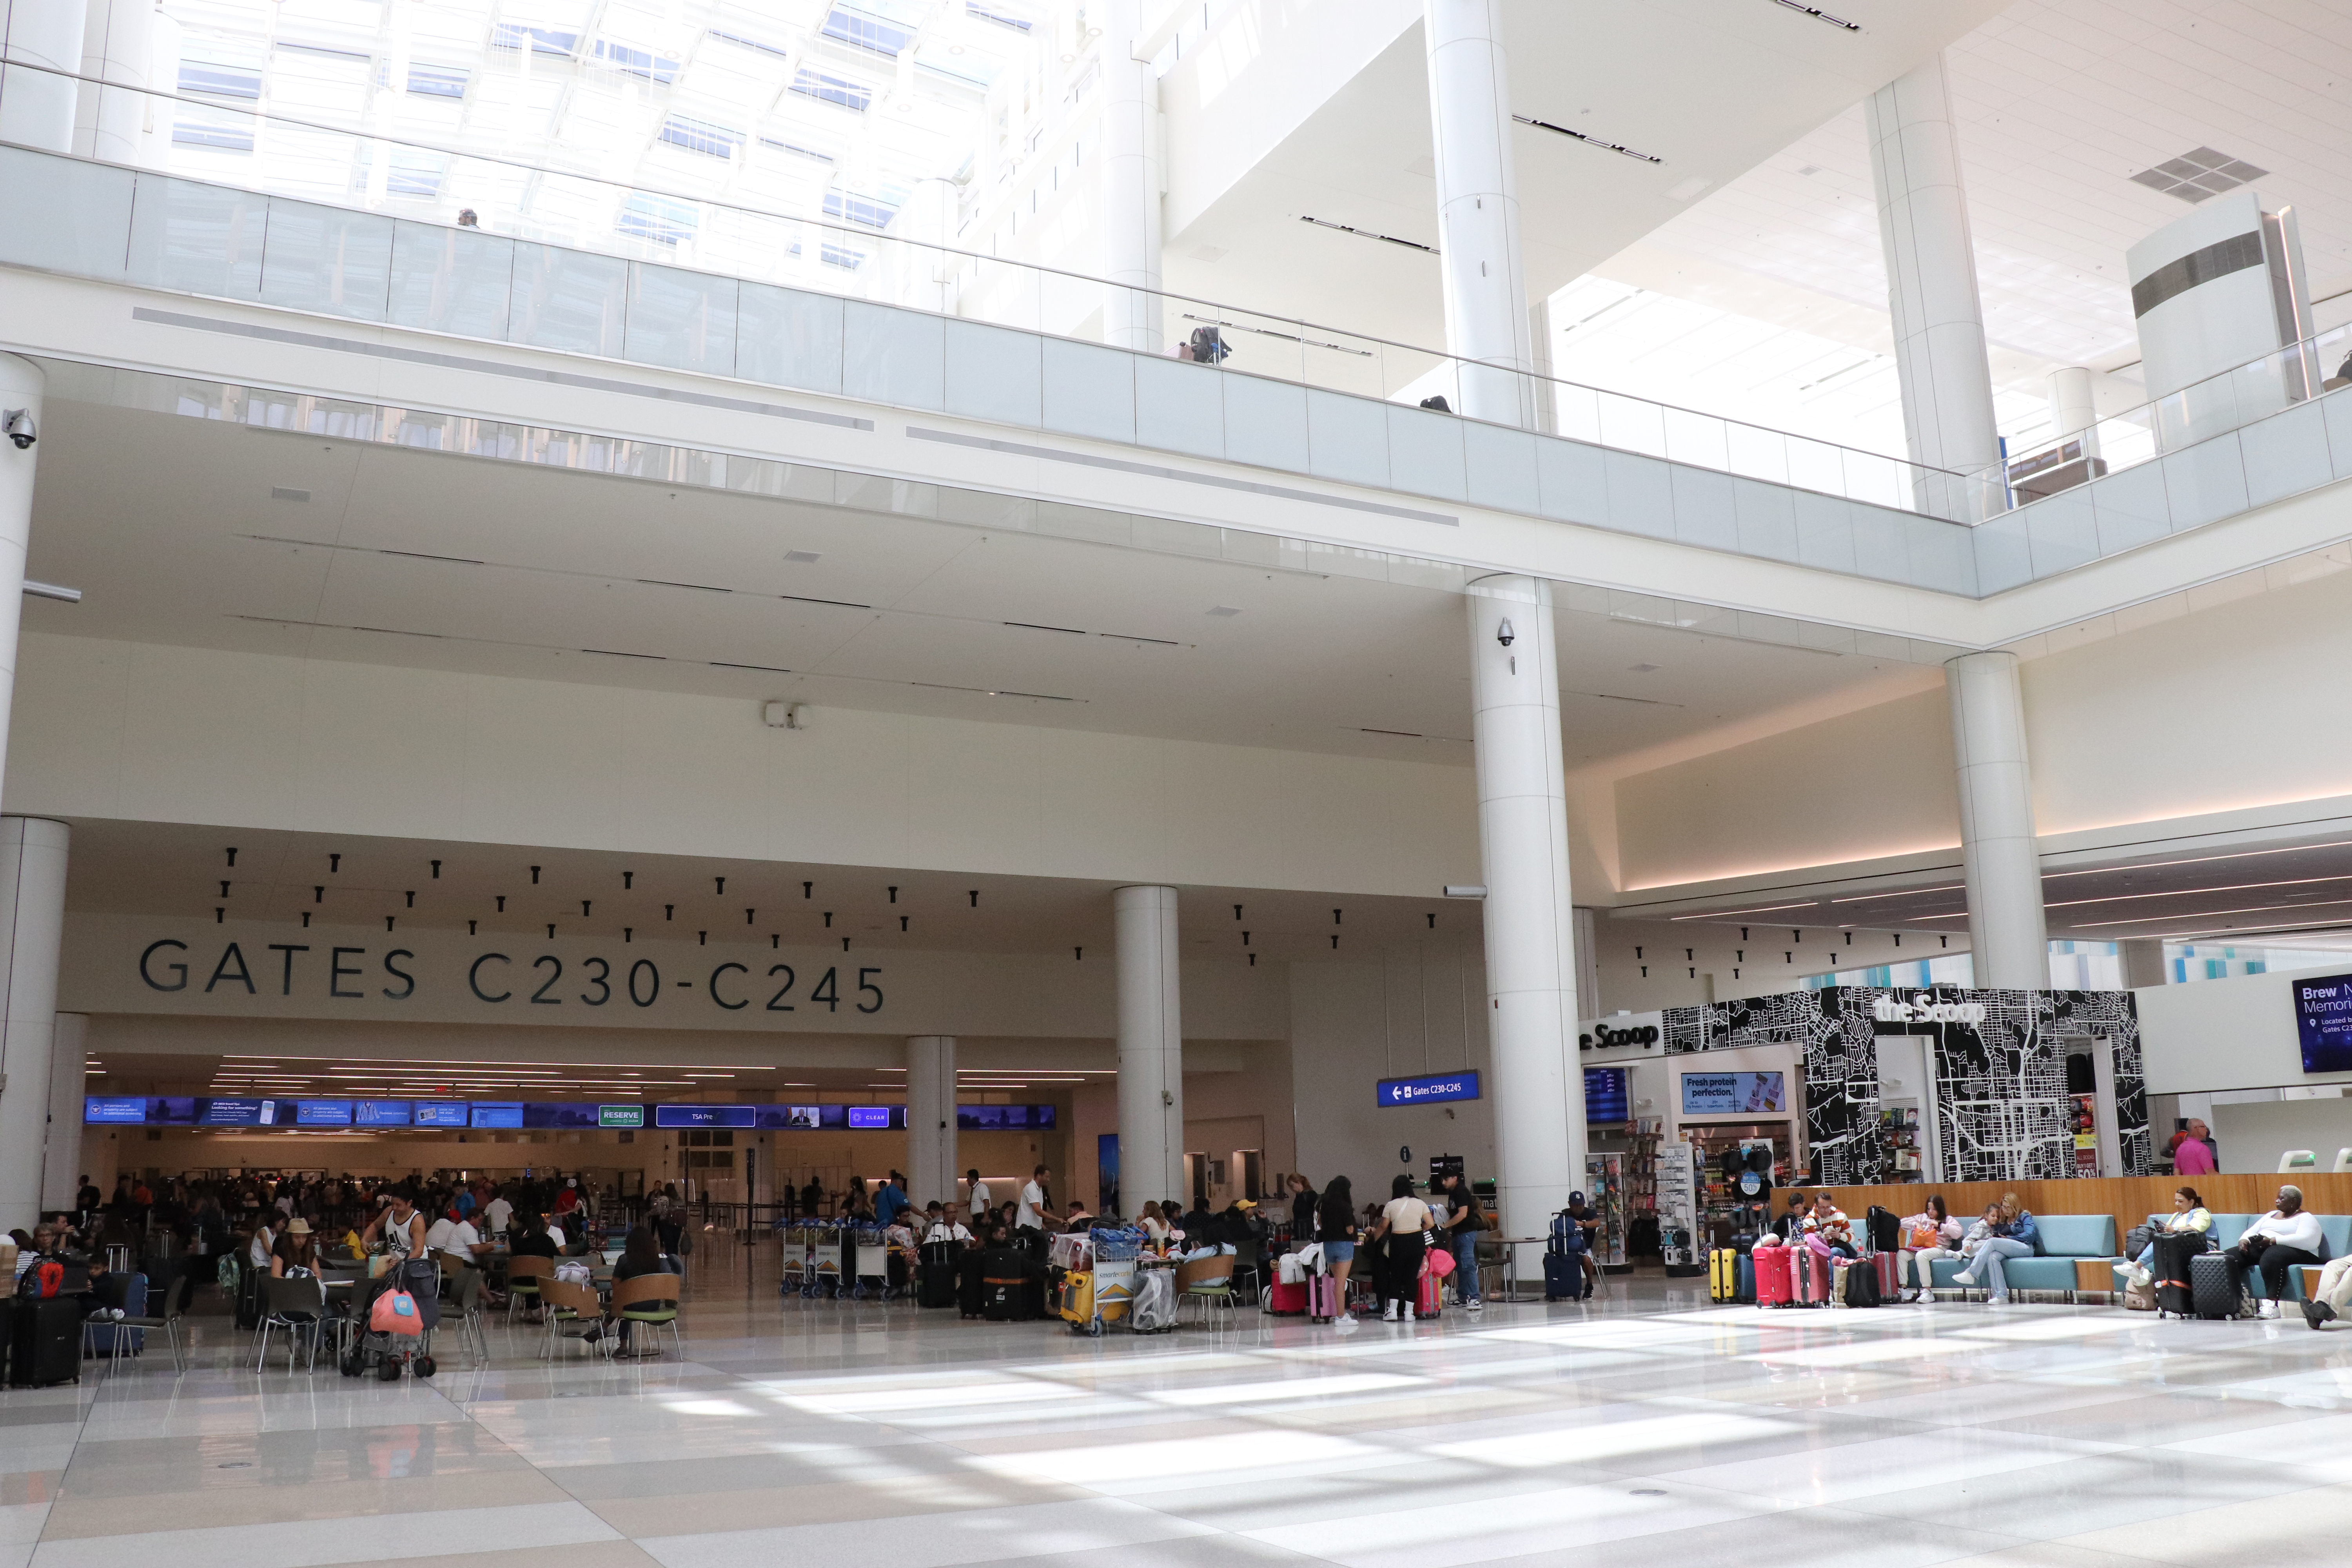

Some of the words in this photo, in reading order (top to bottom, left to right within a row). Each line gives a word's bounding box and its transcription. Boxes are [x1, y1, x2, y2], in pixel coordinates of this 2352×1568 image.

[140, 939, 416, 1000] GATES
[469, 953, 884, 1013] C230-C245
[2303, 988, 2337, 999] Brew
[1872, 994, 1913, 1022] the
[1916, 995, 1985, 1028] Scoop
[2304, 998, 2352, 1013] Memori
[1595, 1024, 1659, 1049] Scoop
[1431, 1083, 1461, 1094] C230-C245
[1710, 1078, 1737, 1087] protein
[1692, 1088, 1733, 1098] perfection.
